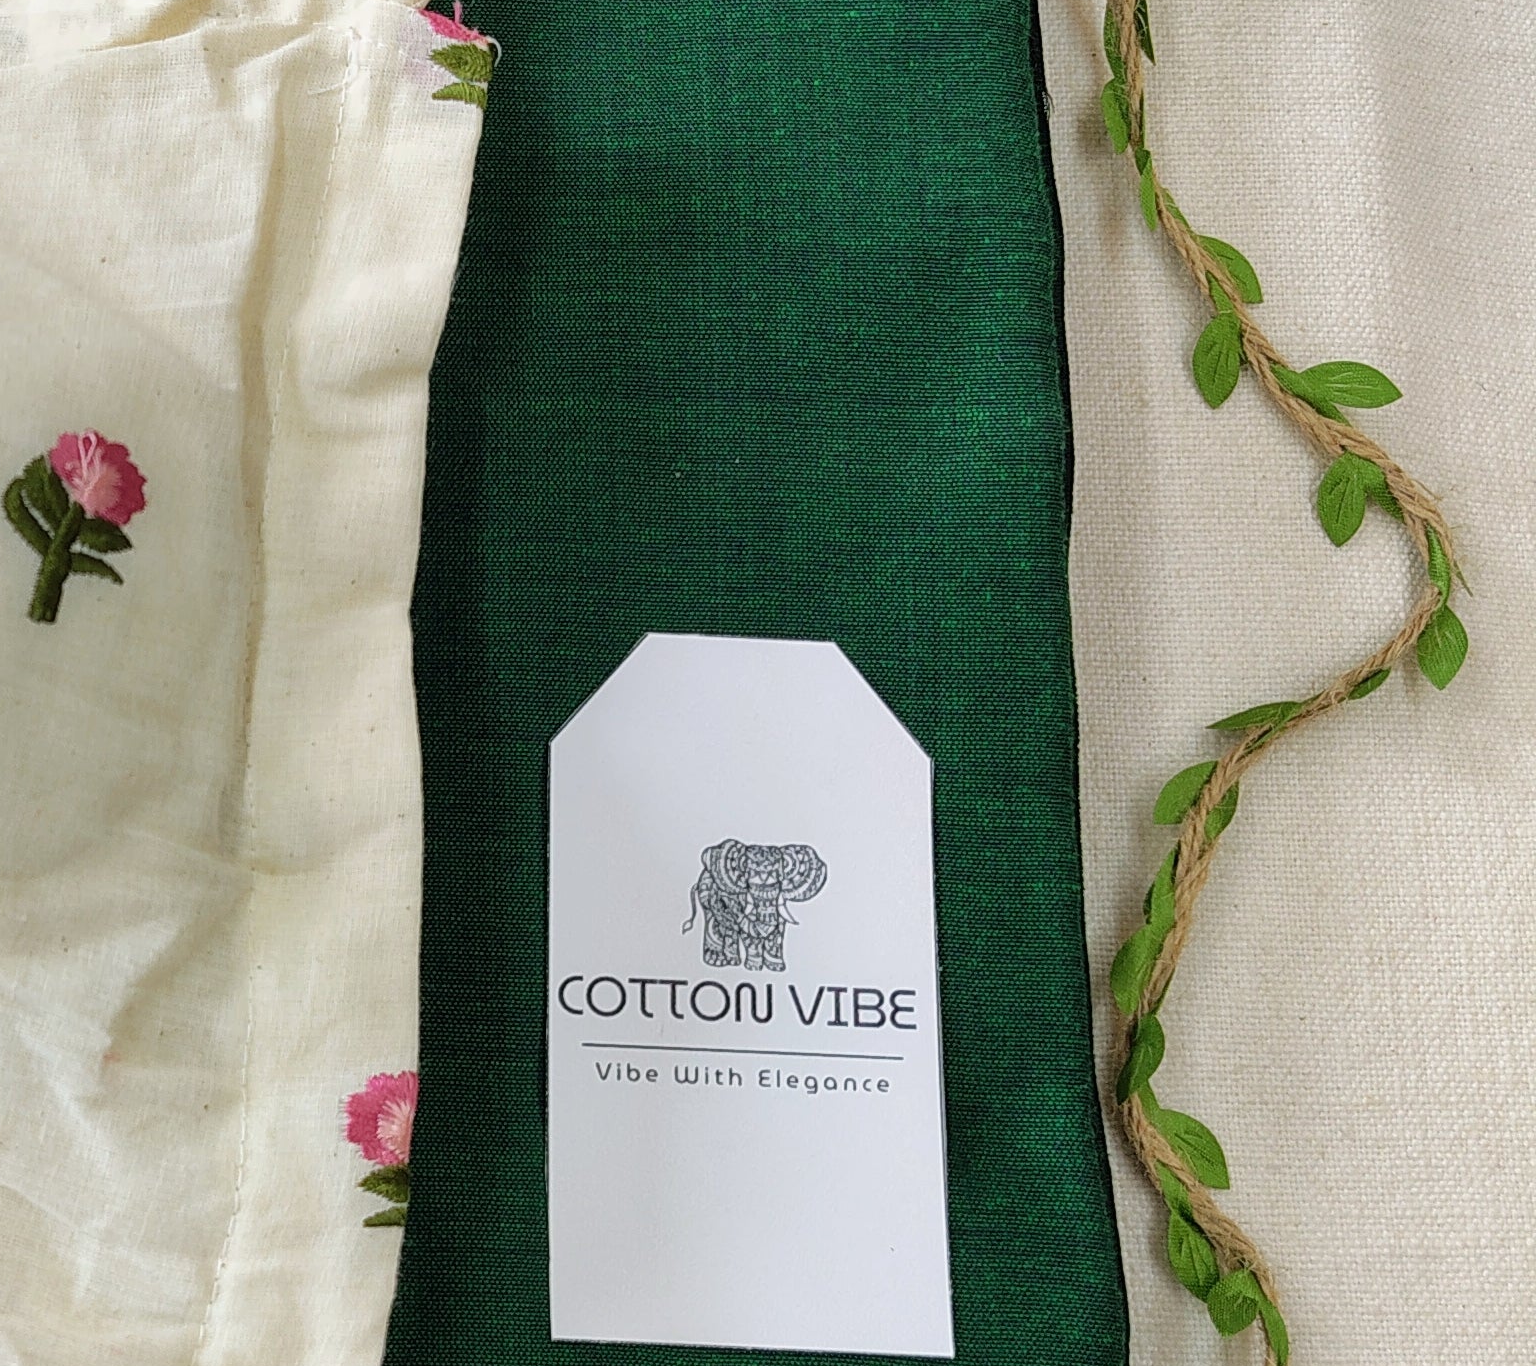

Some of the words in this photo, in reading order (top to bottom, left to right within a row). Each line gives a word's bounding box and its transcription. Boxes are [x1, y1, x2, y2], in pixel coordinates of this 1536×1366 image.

[557, 974, 773, 1024] COTTON
[787, 983, 917, 1030] VIBE
[595, 1061, 659, 1083] Vibe
[674, 1065, 742, 1087] With
[757, 1068, 891, 1095] Elegance
